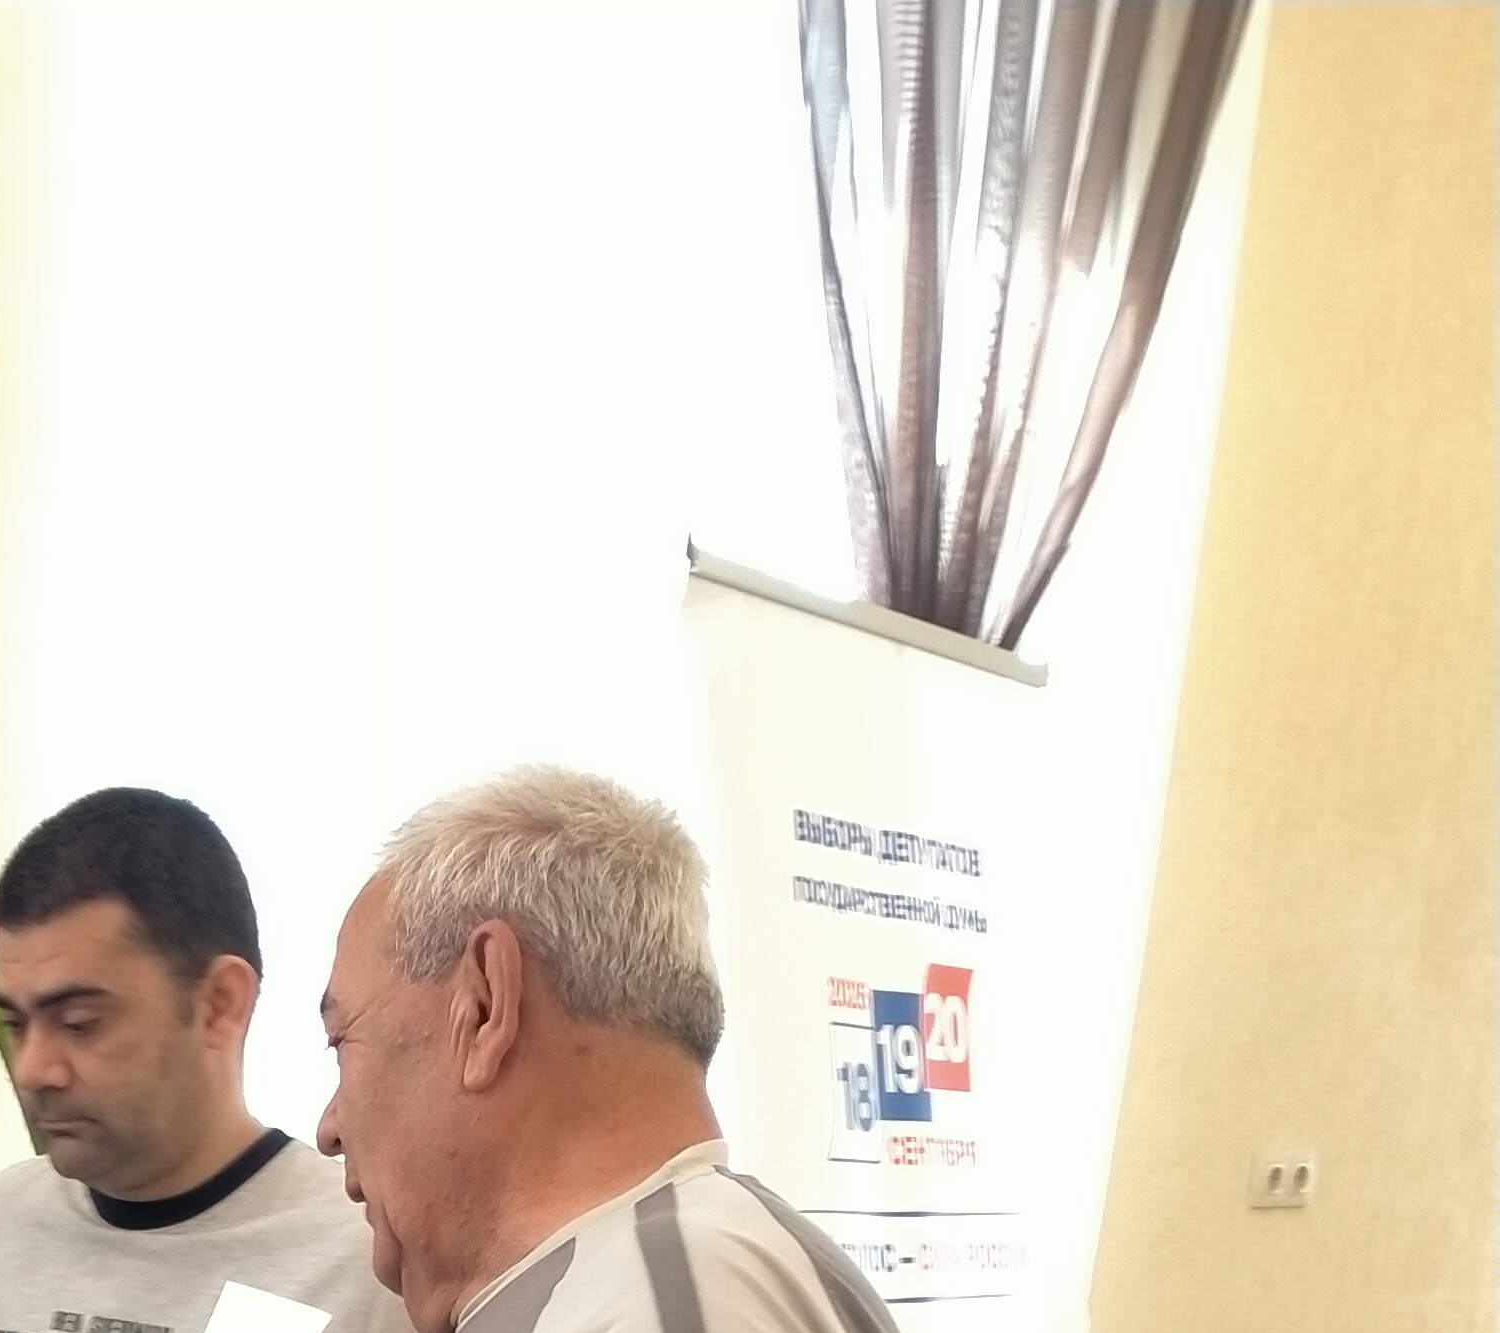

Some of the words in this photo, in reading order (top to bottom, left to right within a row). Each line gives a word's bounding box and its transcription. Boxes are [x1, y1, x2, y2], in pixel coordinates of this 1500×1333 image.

[793, 808, 872, 857] ВЫБОРЫ
[877, 829, 983, 878] ДЕПУТАТОВ
[793, 875, 941, 928] ГОСУДАРСТВЕННОЙ
[943, 904, 988, 934] ДУМЫ
[836, 1062, 875, 1132] 18
[876, 1024, 921, 1094] 19
[925, 992, 968, 1063] 20
[887, 1136, 979, 1168] СЕНТЯБРЯ
